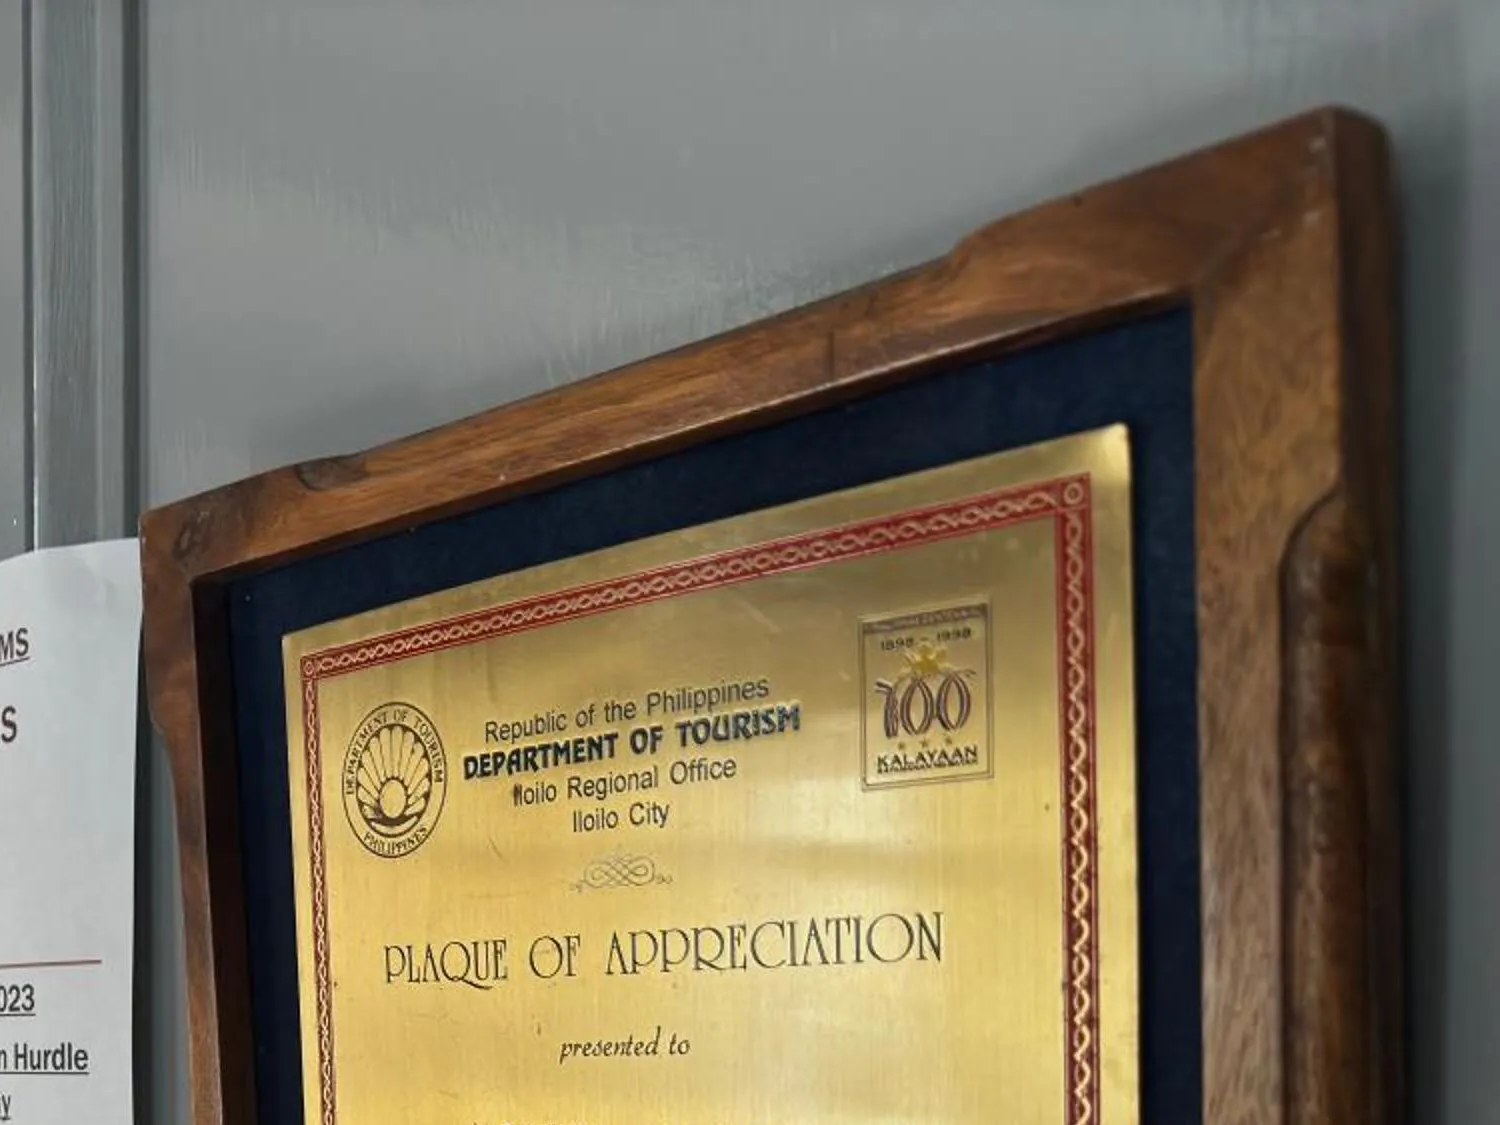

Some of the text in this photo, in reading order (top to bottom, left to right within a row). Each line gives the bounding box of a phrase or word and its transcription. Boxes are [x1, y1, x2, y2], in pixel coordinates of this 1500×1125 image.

[484, 678, 770, 745] Republic of the Philippines
[874, 672, 973, 740] 100
[413, 715, 444, 784] TOURISM
[462, 701, 802, 781] DEPARTMENT OF TOURISM
[876, 745, 979, 773] KALAYAAN
[566, 765, 660, 802] Regional
[668, 756, 738, 786] Office
[572, 801, 672, 834] Iloilo City
[363, 827, 428, 856] PHILIPPINES
[383, 910, 945, 991] PLAQUE OF APPRECIATION
[14, 1041, 89, 1071] Hurdle
[558, 1025, 692, 1066] presented to
